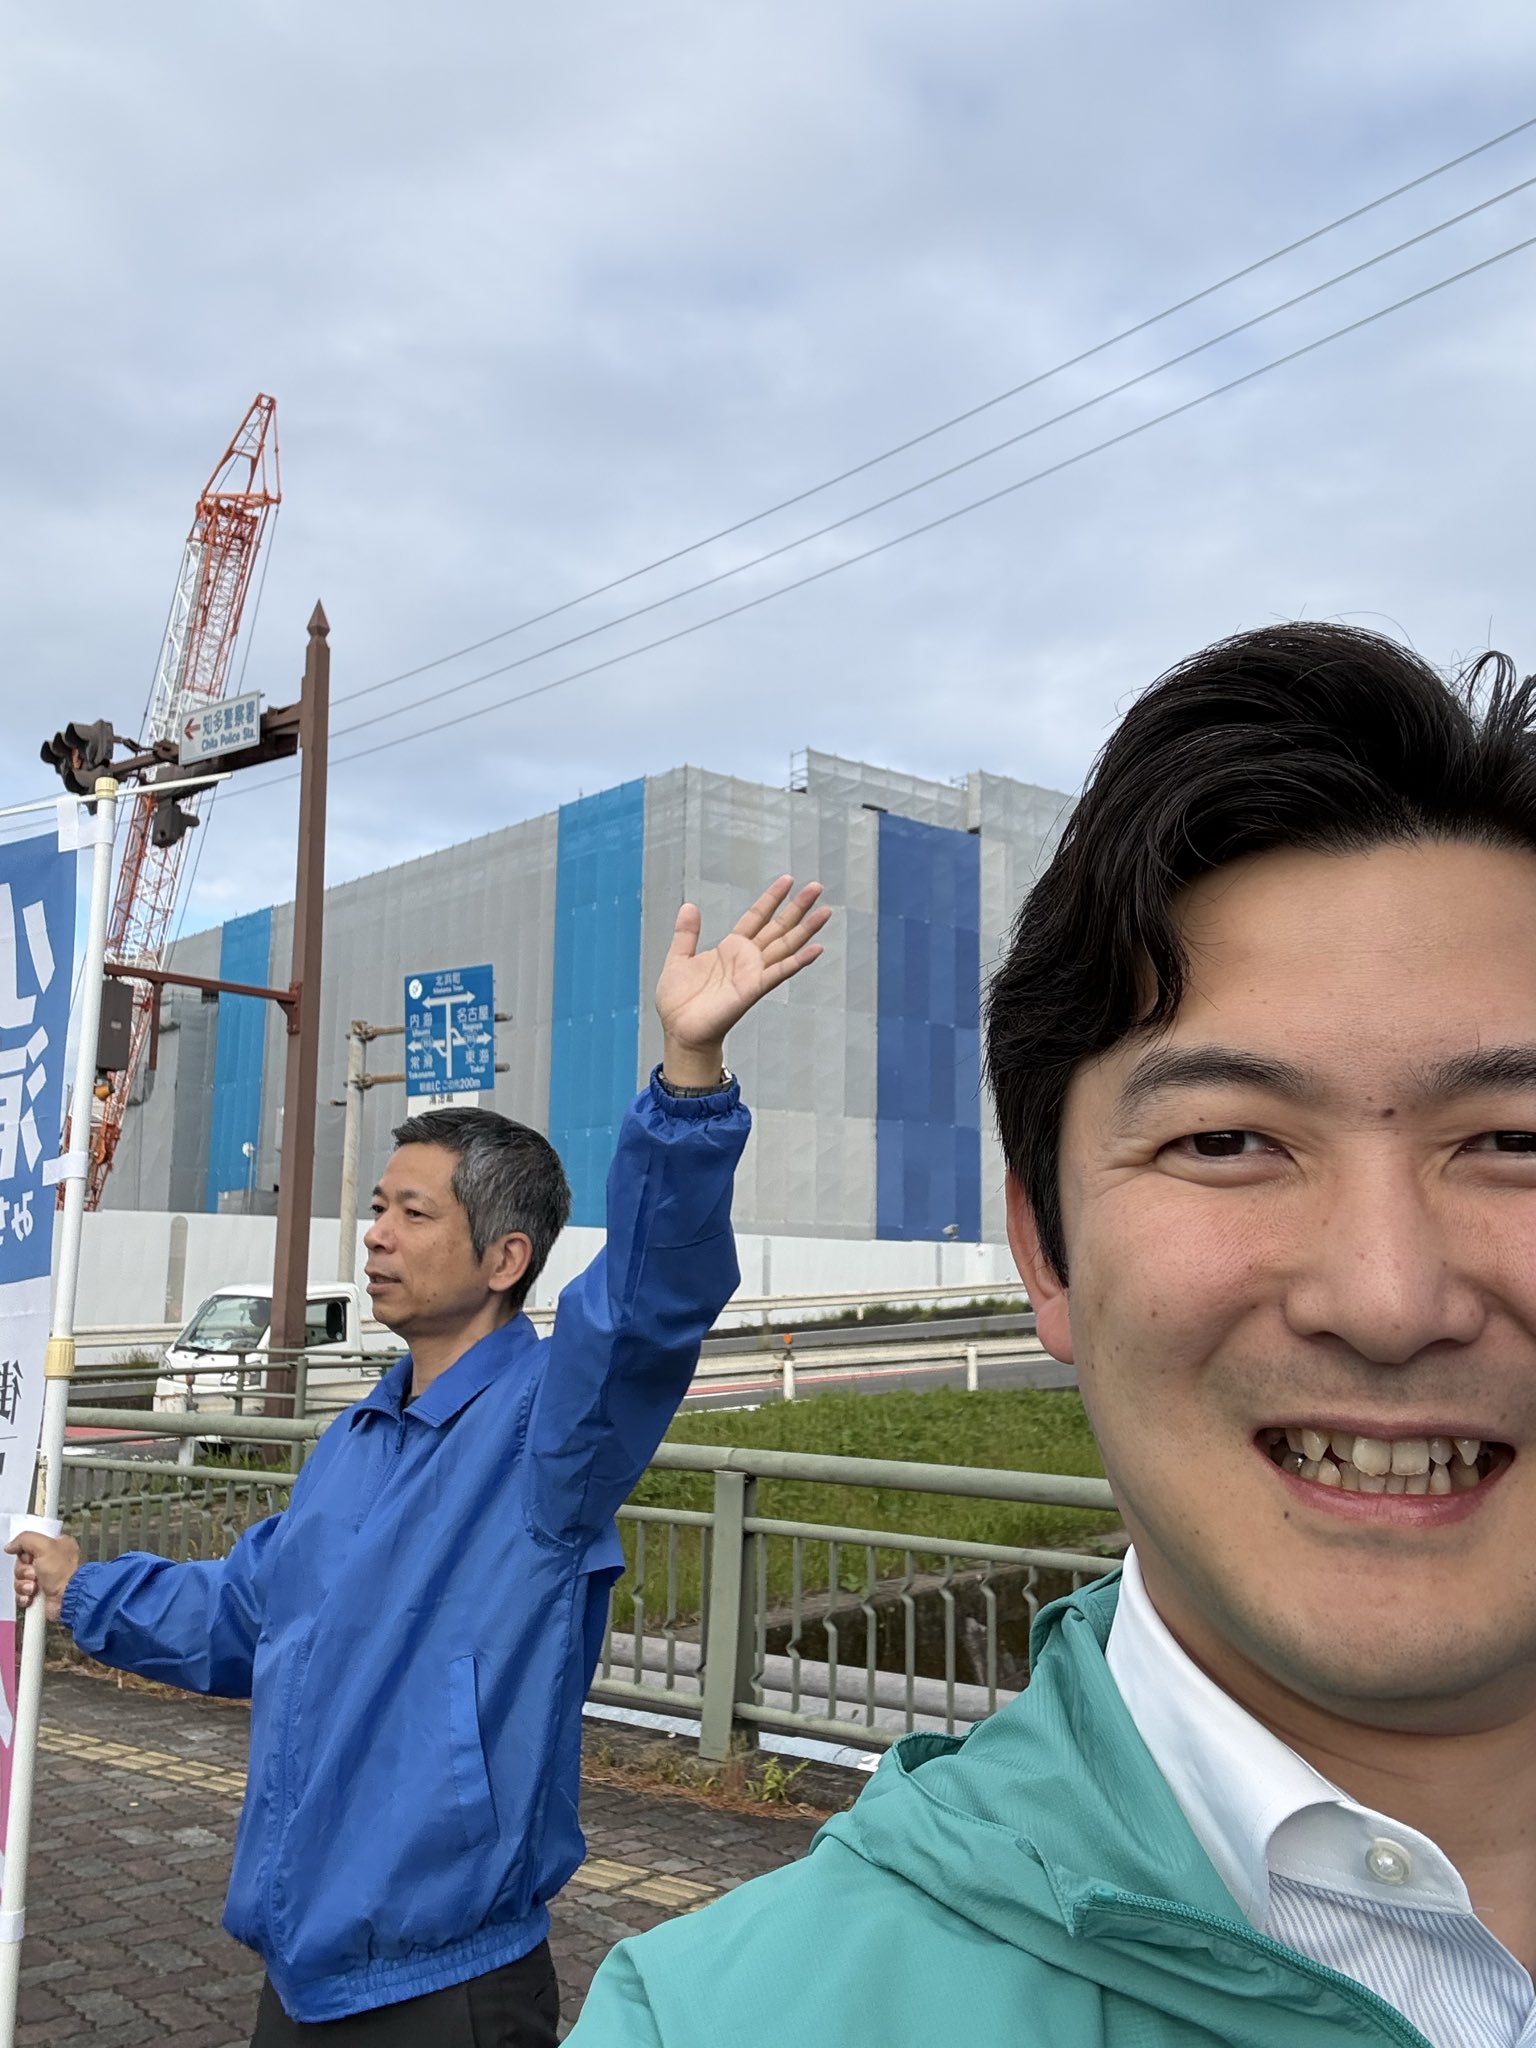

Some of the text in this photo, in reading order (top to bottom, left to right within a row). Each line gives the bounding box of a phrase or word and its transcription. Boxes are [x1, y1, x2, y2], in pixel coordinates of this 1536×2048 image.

[202, 701, 256, 736] 知多警察署
[220, 732, 240, 746] Police
[410, 1012, 432, 1028] 内海
[457, 1005, 488, 1023] 名古屋
[465, 1048, 489, 1065] 東海
